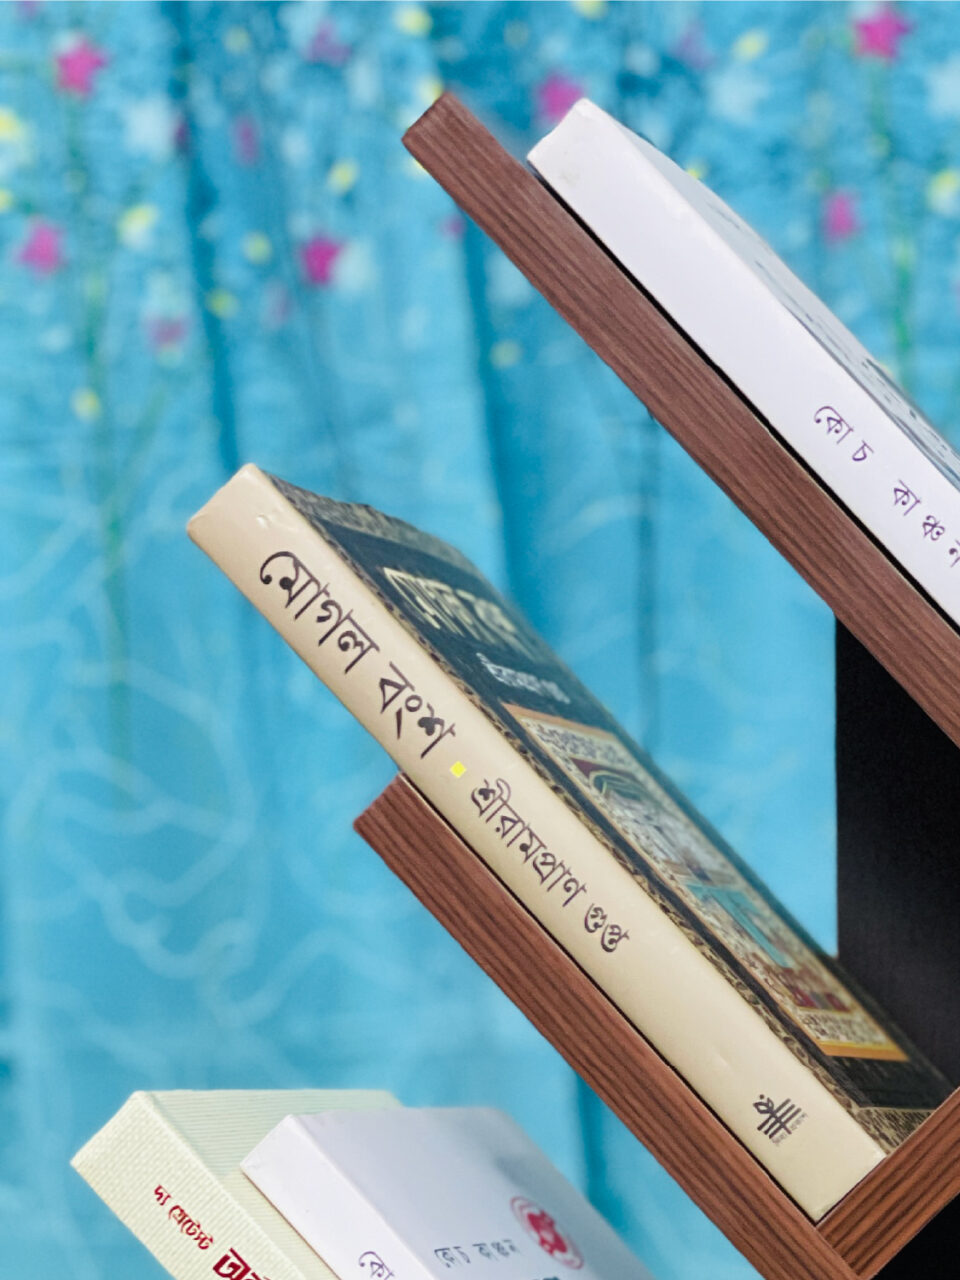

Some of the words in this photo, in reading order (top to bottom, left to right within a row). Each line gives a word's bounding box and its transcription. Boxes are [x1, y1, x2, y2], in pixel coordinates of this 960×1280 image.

[259, 551, 379, 674] মোগল
[380, 662, 456, 759] বংশ
[584, 903, 630, 952] গুপ্ত
